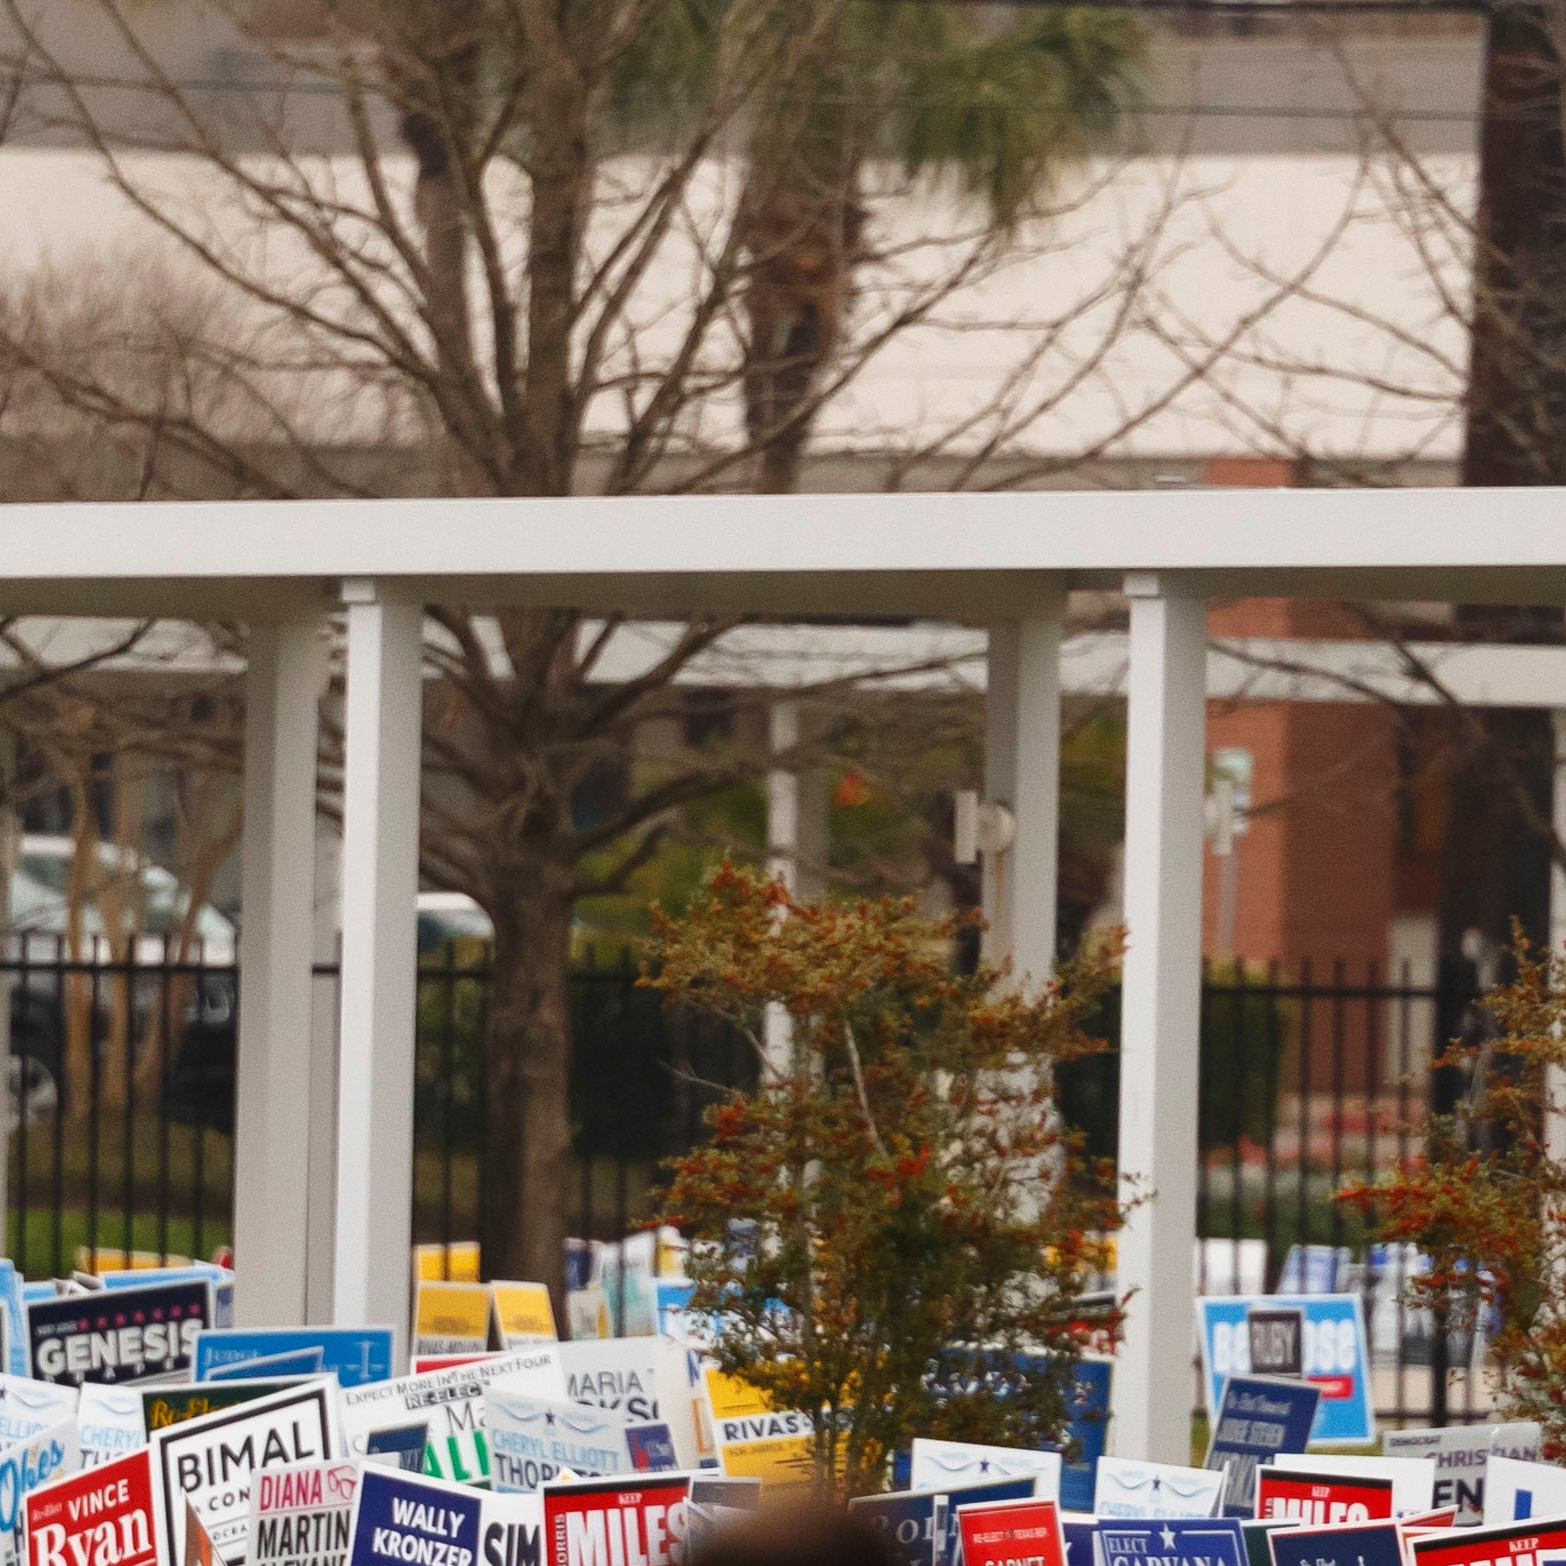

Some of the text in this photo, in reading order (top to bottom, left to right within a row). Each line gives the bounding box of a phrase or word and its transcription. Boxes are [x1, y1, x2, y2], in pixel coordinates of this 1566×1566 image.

[37, 1318, 204, 1377] GENESIS
[397, 1379, 433, 1396] MORE
[480, 1362, 514, 1378] NEXT
[515, 1354, 553, 1371] FOUR
[178, 1421, 315, 1493] BIMAL
[491, 1429, 621, 1472] CHERYL ELLIOTT
[68, 1478, 130, 1522] VINCE
[260, 1469, 323, 1511] DIANA
[393, 1497, 466, 1539] WALLY
[1108, 1537, 1148, 1554] ELECT
[1508, 1538, 1539, 1553] KEEP
